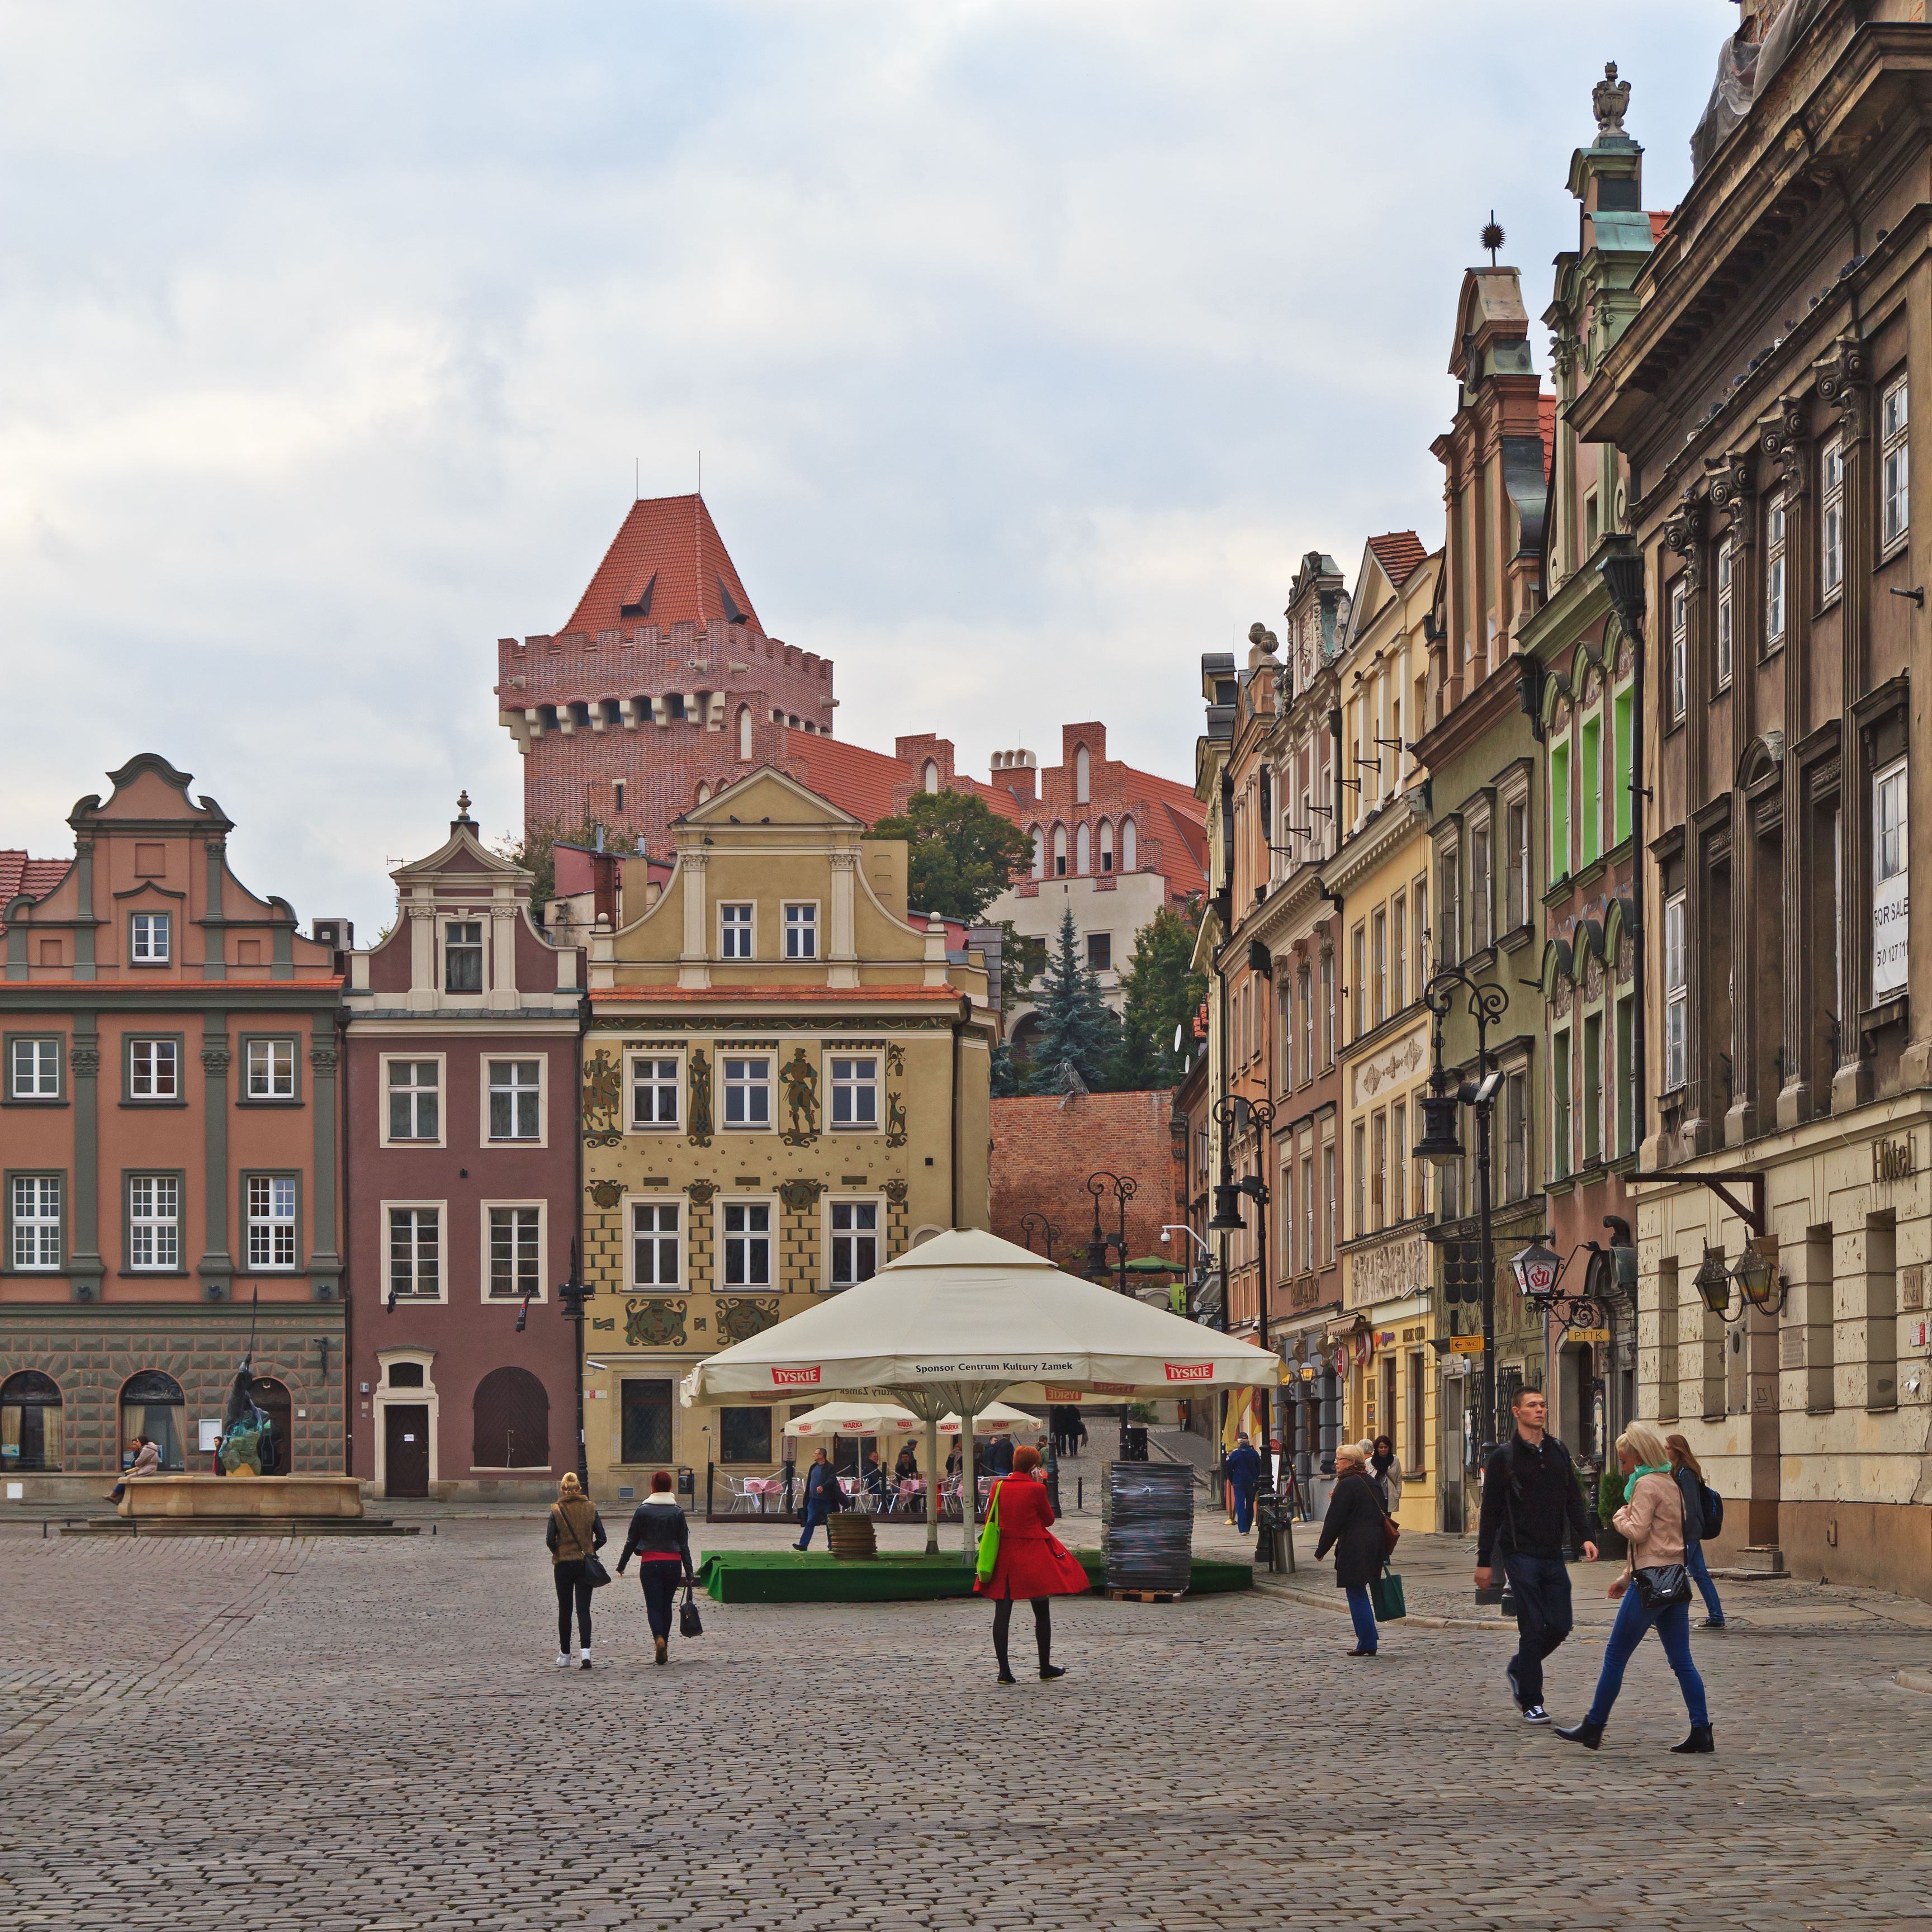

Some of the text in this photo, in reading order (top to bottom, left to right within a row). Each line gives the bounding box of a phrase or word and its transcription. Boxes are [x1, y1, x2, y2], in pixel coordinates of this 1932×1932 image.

[1874, 896, 1909, 927] FOR SALE
[1871, 1130, 1911, 1183] Hotel
[1574, 1331, 1603, 1339] PTTK
[916, 1365, 955, 1374] Sponsor
[1003, 1362, 1038, 1371] Kultury
[1168, 1366, 1210, 1378] TYSKIE
[775, 1369, 818, 1382] TYSKIE
